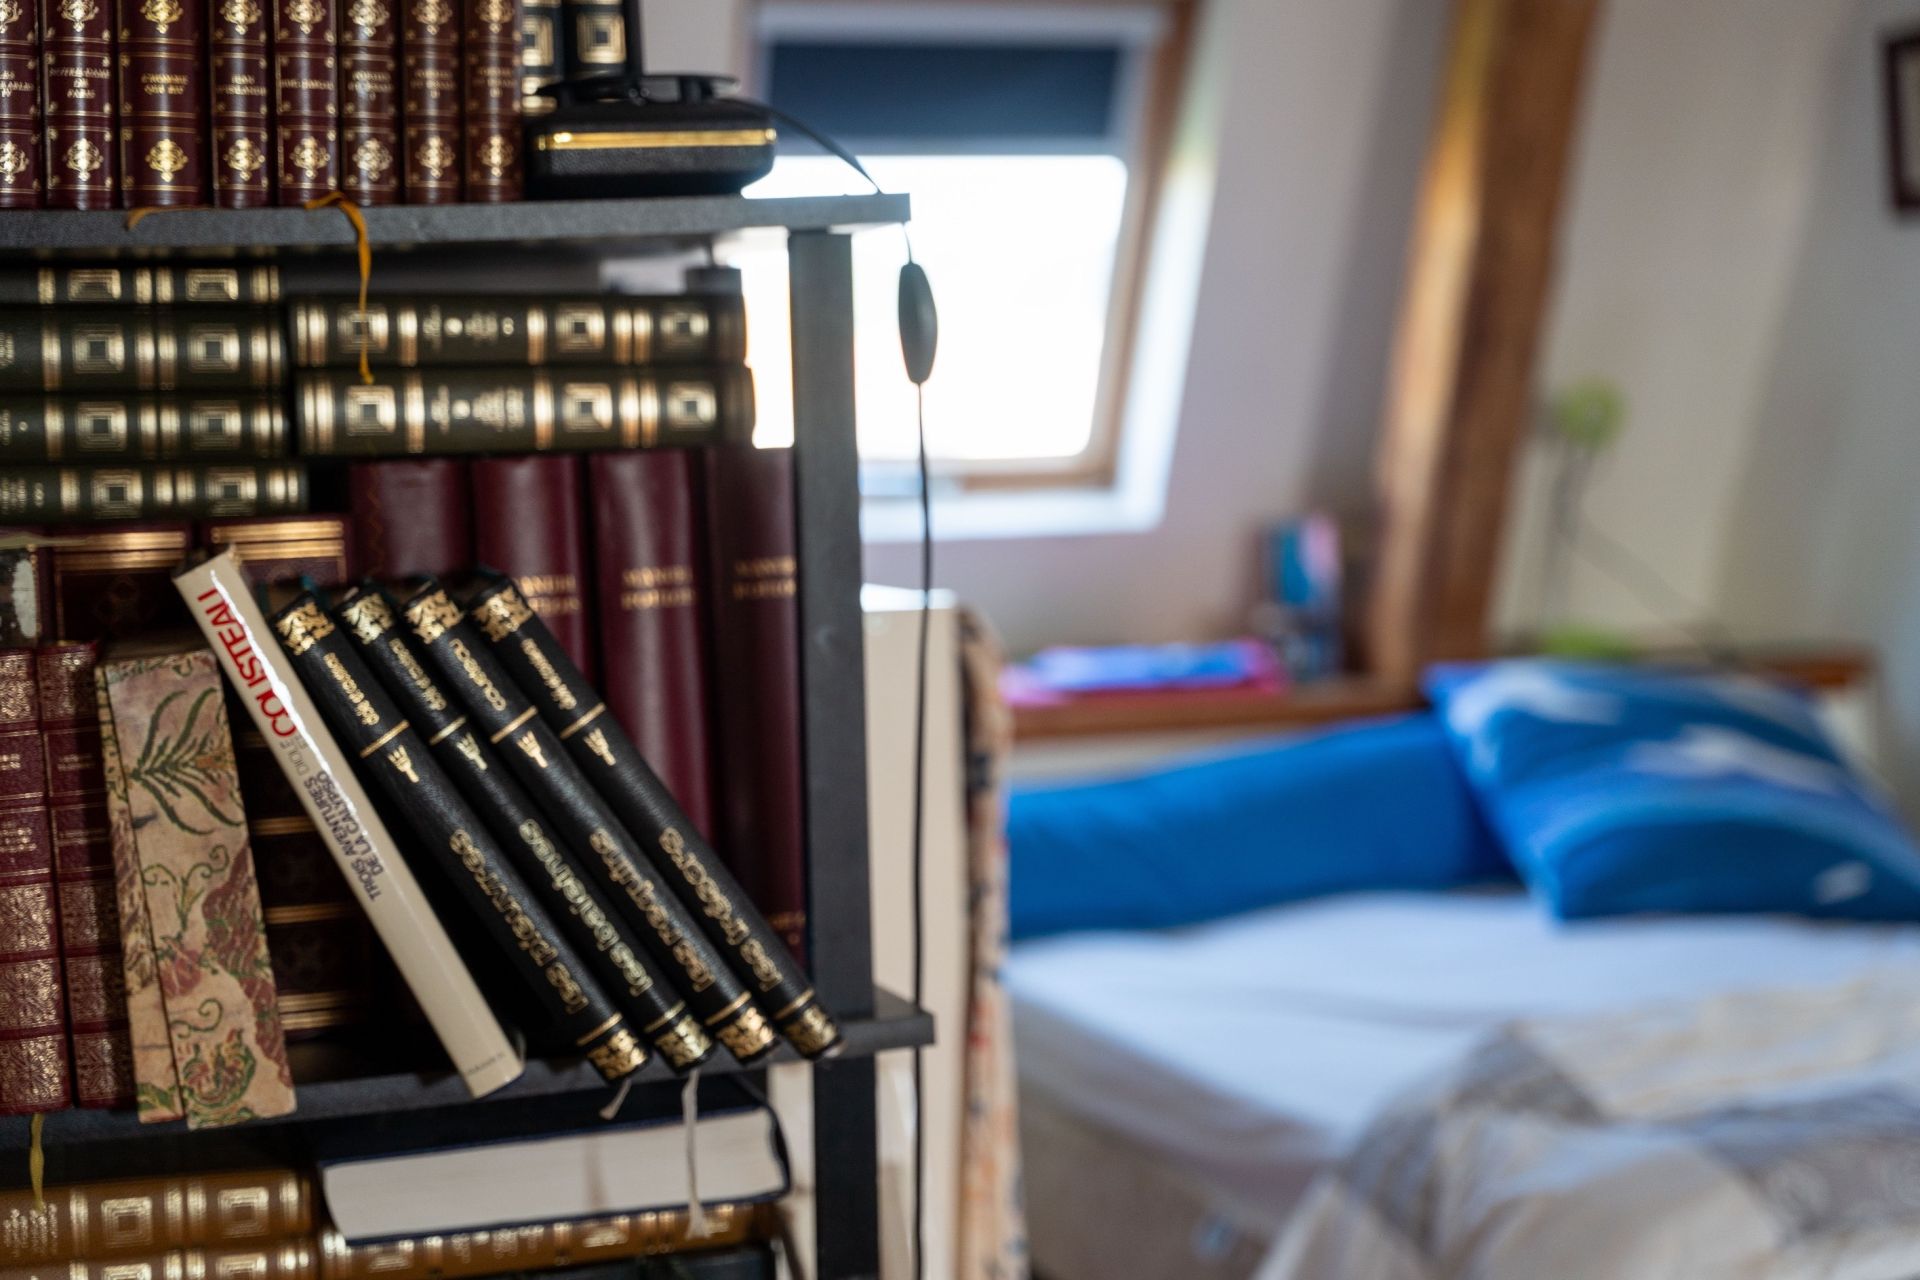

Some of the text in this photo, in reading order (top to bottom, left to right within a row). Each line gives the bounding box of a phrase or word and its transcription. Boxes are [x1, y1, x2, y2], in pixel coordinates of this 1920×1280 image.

[196, 586, 299, 742] COUSTEAU
[447, 639, 507, 714] cousteau
[302, 776, 383, 901] TROIS AVENTURES
[314, 769, 385, 877] DE LA CALYPSO
[451, 826, 559, 963] pieuvres
[519, 819, 653, 994] les baleines
[591, 826, 718, 987] les requins
[660, 825, 785, 983] les trésors
[550, 962, 588, 1004] les
